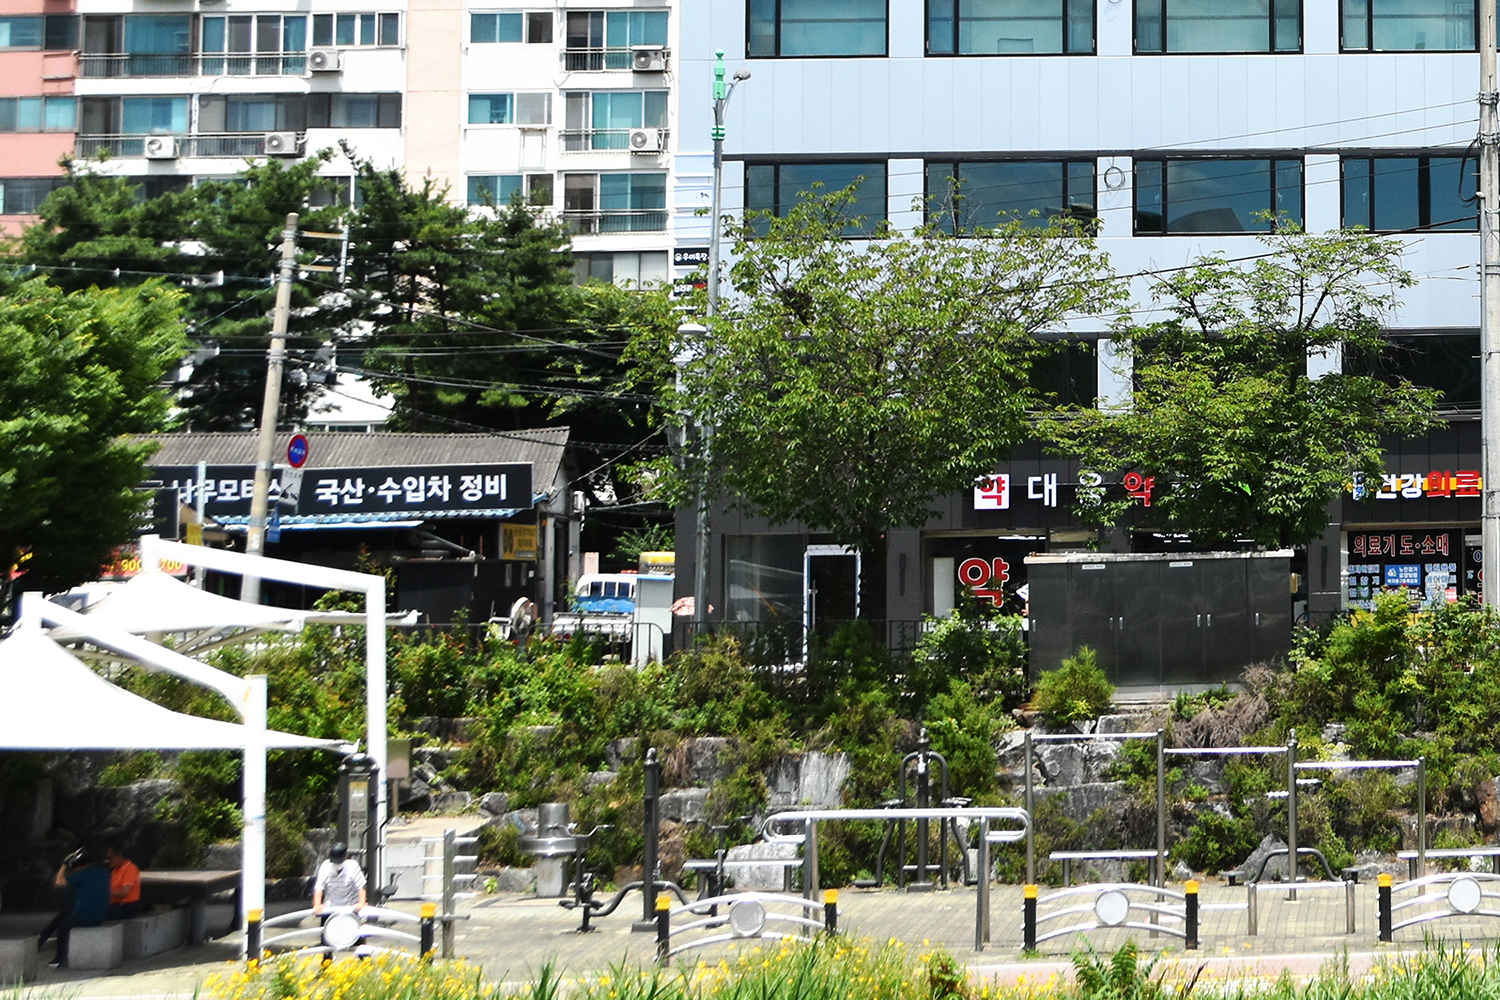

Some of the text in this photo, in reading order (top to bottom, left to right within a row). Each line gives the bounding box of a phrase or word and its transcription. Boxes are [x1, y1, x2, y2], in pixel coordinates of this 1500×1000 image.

[315, 475, 451, 505] 국산·수입차
[459, 474, 507, 501] 정비
[1354, 534, 1396, 557] 의료기
[1400, 533, 1450, 556] 도·소매
[958, 557, 1010, 608] 약
